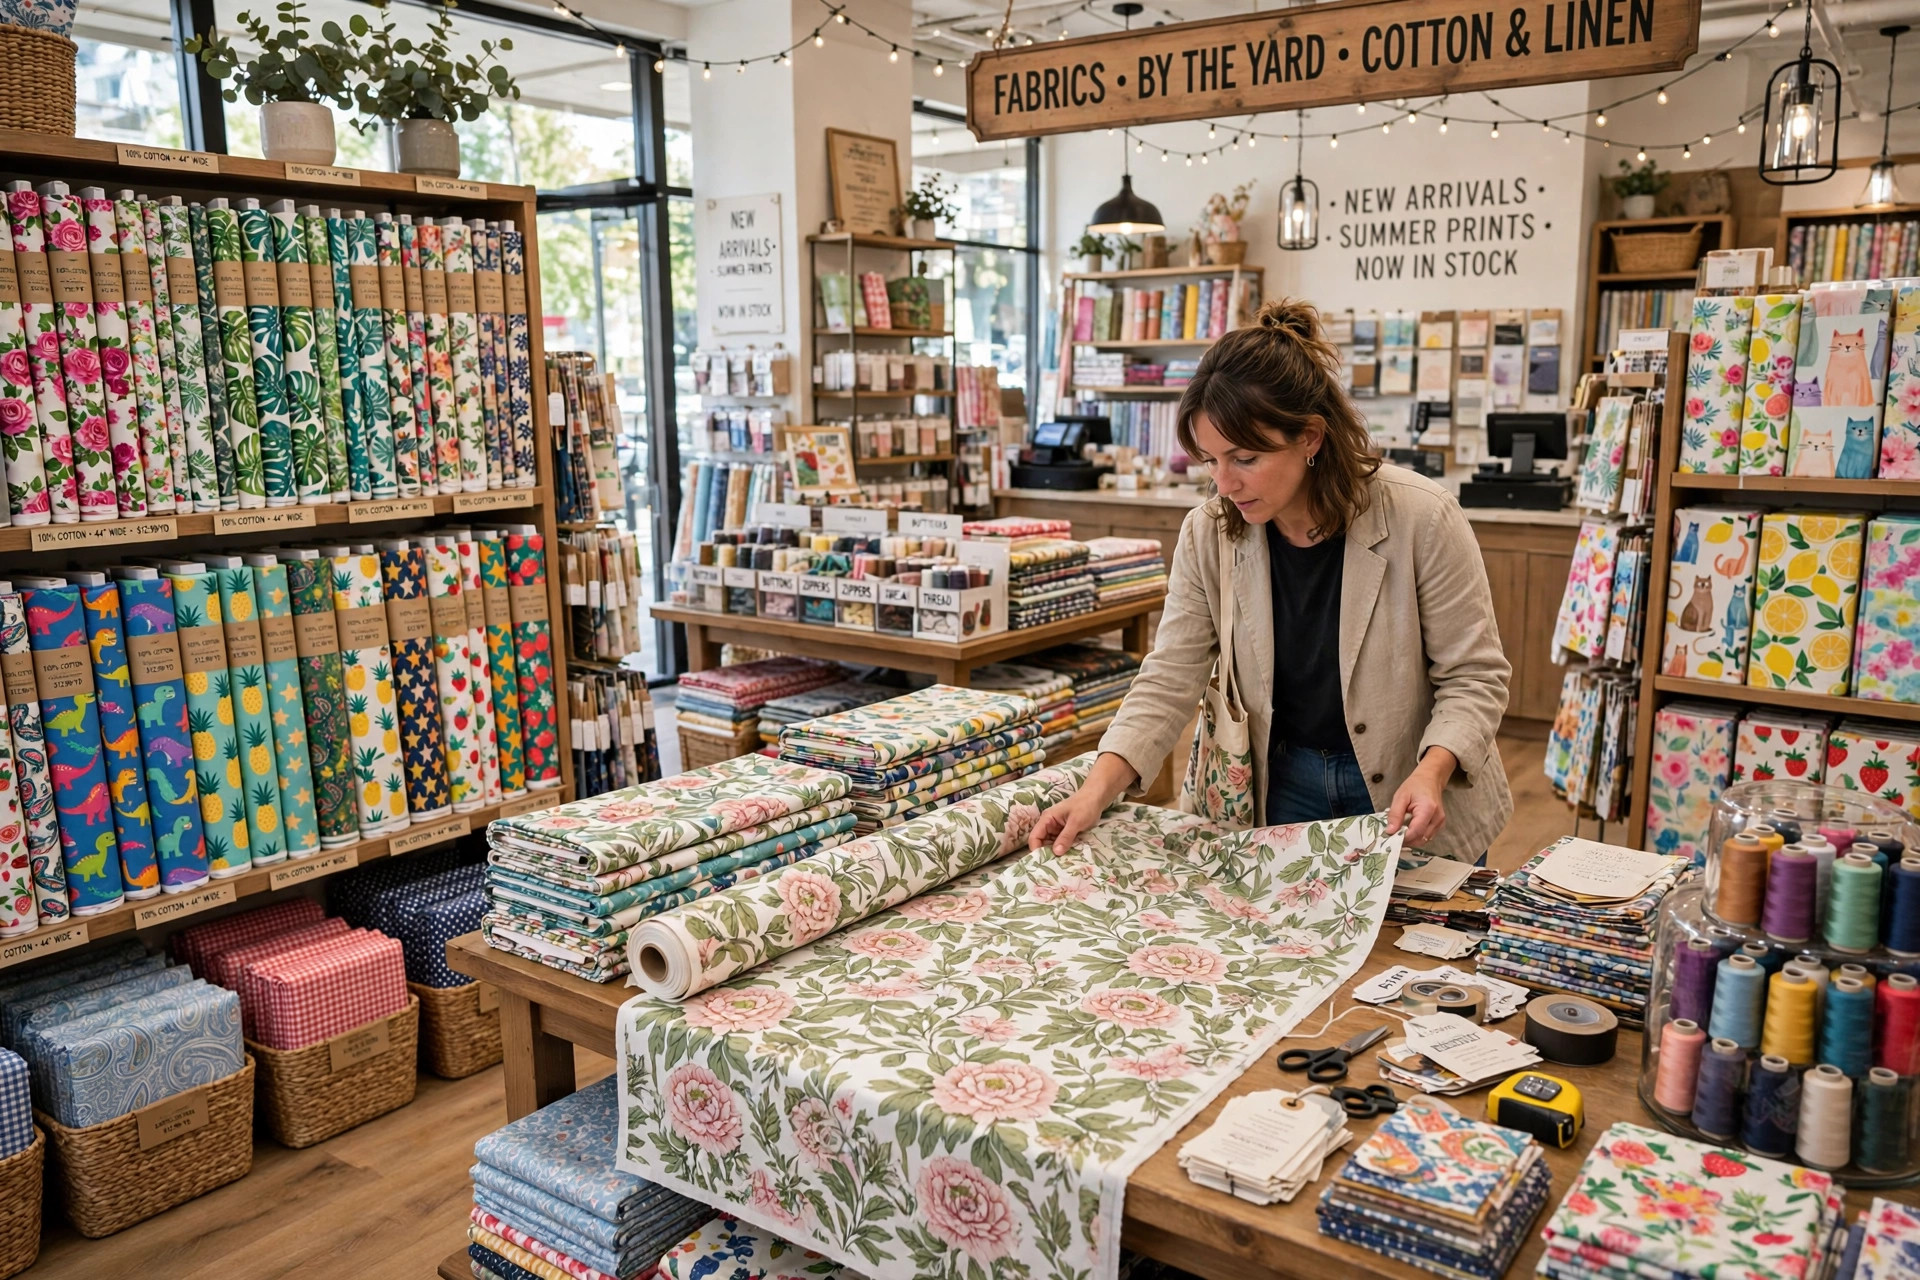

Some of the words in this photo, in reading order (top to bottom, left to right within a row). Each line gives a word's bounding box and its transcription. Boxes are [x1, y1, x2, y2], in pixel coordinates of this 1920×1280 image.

[994, 61, 1105, 115] FABRICS
[1138, 52, 1173, 99] BY
[1182, 46, 1236, 94] THE
[1248, 34, 1325, 87] YARD
[1362, 12, 1491, 73] COTTON
[1505, 7, 1531, 57] &
[1544, 0, 1655, 53] LINEN
[143, 152, 170, 162] COTTON
[192, 157, 209, 166] WIDE
[305, 167, 326, 176] COTTON
[1344, 187, 1396, 215] NEW
[1405, 177, 1528, 211] ARRIVALS
[730, 210, 755, 230] NEW
[1340, 219, 1436, 248] SUMMER
[1447, 213, 1536, 243] PRINTS
[719, 238, 771, 260] ARRIVALS
[1355, 255, 1404, 281] NOW
[1413, 253, 1435, 278] IN
[1444, 249, 1519, 277] STOCK
[718, 304, 735, 319] NOW
[738, 304, 746, 318] IN
[749, 304, 772, 318] STOCK
[474, 495, 496, 505] COTTON
[370, 505, 394, 514] COTTON
[237, 515, 265, 526] COTTON
[286, 512, 303, 521] WIDE
[57, 530, 87, 541] COTTON
[109, 527, 127, 537] WIDE
[802, 580, 830, 594] ZIPPERS
[842, 584, 872, 599] ZIPPERS
[923, 593, 952, 606] THREAD
[60, 661, 84, 670] COTTON
[409, 833, 432, 845] COTTON
[291, 865, 315, 879] COTTON
[158, 901, 185, 916] COTTON
[202, 891, 221, 903] WIDE
[3, 944, 33, 959] COTTON
[54, 932, 72, 945] WIDE
